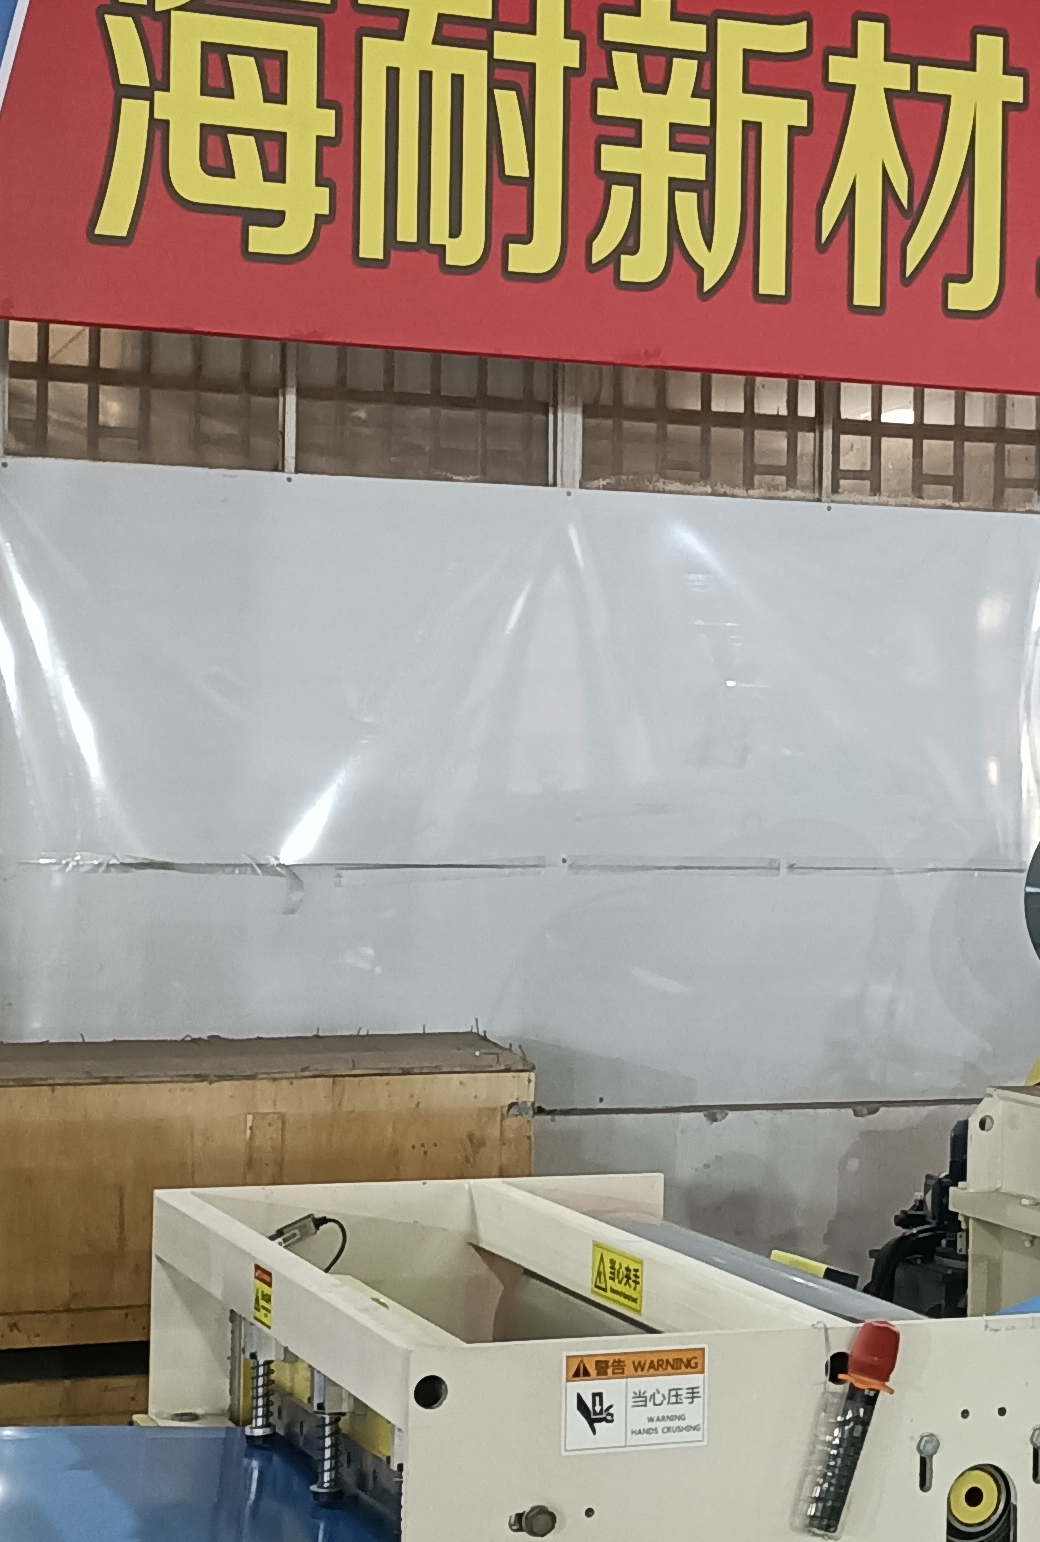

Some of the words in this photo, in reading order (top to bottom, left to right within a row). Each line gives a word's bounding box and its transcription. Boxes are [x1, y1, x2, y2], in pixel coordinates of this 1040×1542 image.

[594, 1358, 627, 1377] 警告
[632, 1356, 699, 1373] WARNING
[630, 1385, 702, 1408] 当心压手
[646, 1413, 687, 1424] WARNING
[630, 1424, 659, 1436] HANDS
[661, 1423, 702, 1435] CRUSHING
